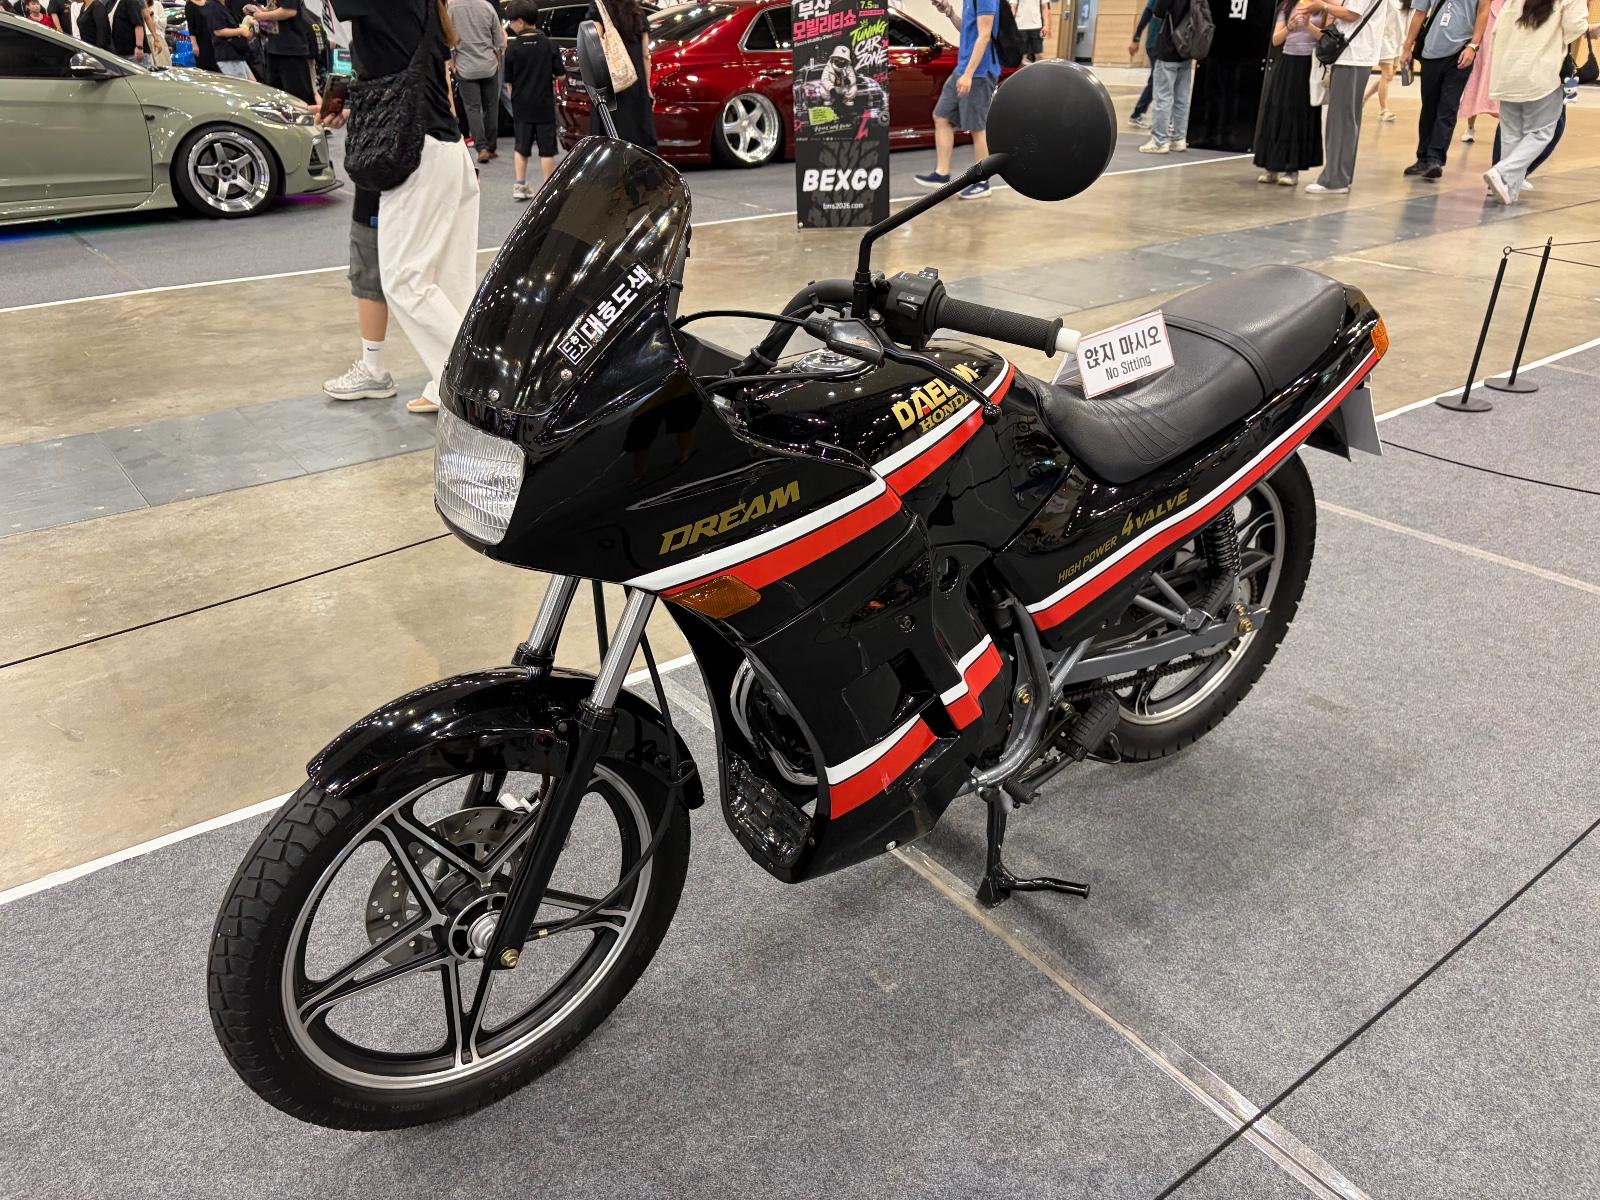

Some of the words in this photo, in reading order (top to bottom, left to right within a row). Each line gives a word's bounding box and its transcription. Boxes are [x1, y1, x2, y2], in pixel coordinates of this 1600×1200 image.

[792, 9, 857, 41] 모빌리티쇼
[850, 20, 888, 47] TUNING
[854, 48, 888, 71] ZONE
[855, 35, 882, 56] CAR
[802, 168, 884, 192] BEXCO
[580, 264, 654, 341] 대호도색
[1084, 341, 1115, 370] 앉지
[1118, 326, 1162, 356] 마시오
[1105, 366, 1120, 381] No
[1120, 355, 1152, 375] Sitting
[891, 363, 980, 431] DAELM
[658, 480, 801, 555] DREAM
[1057, 561, 1082, 584] HIGH
[1082, 535, 1118, 568] POWER
